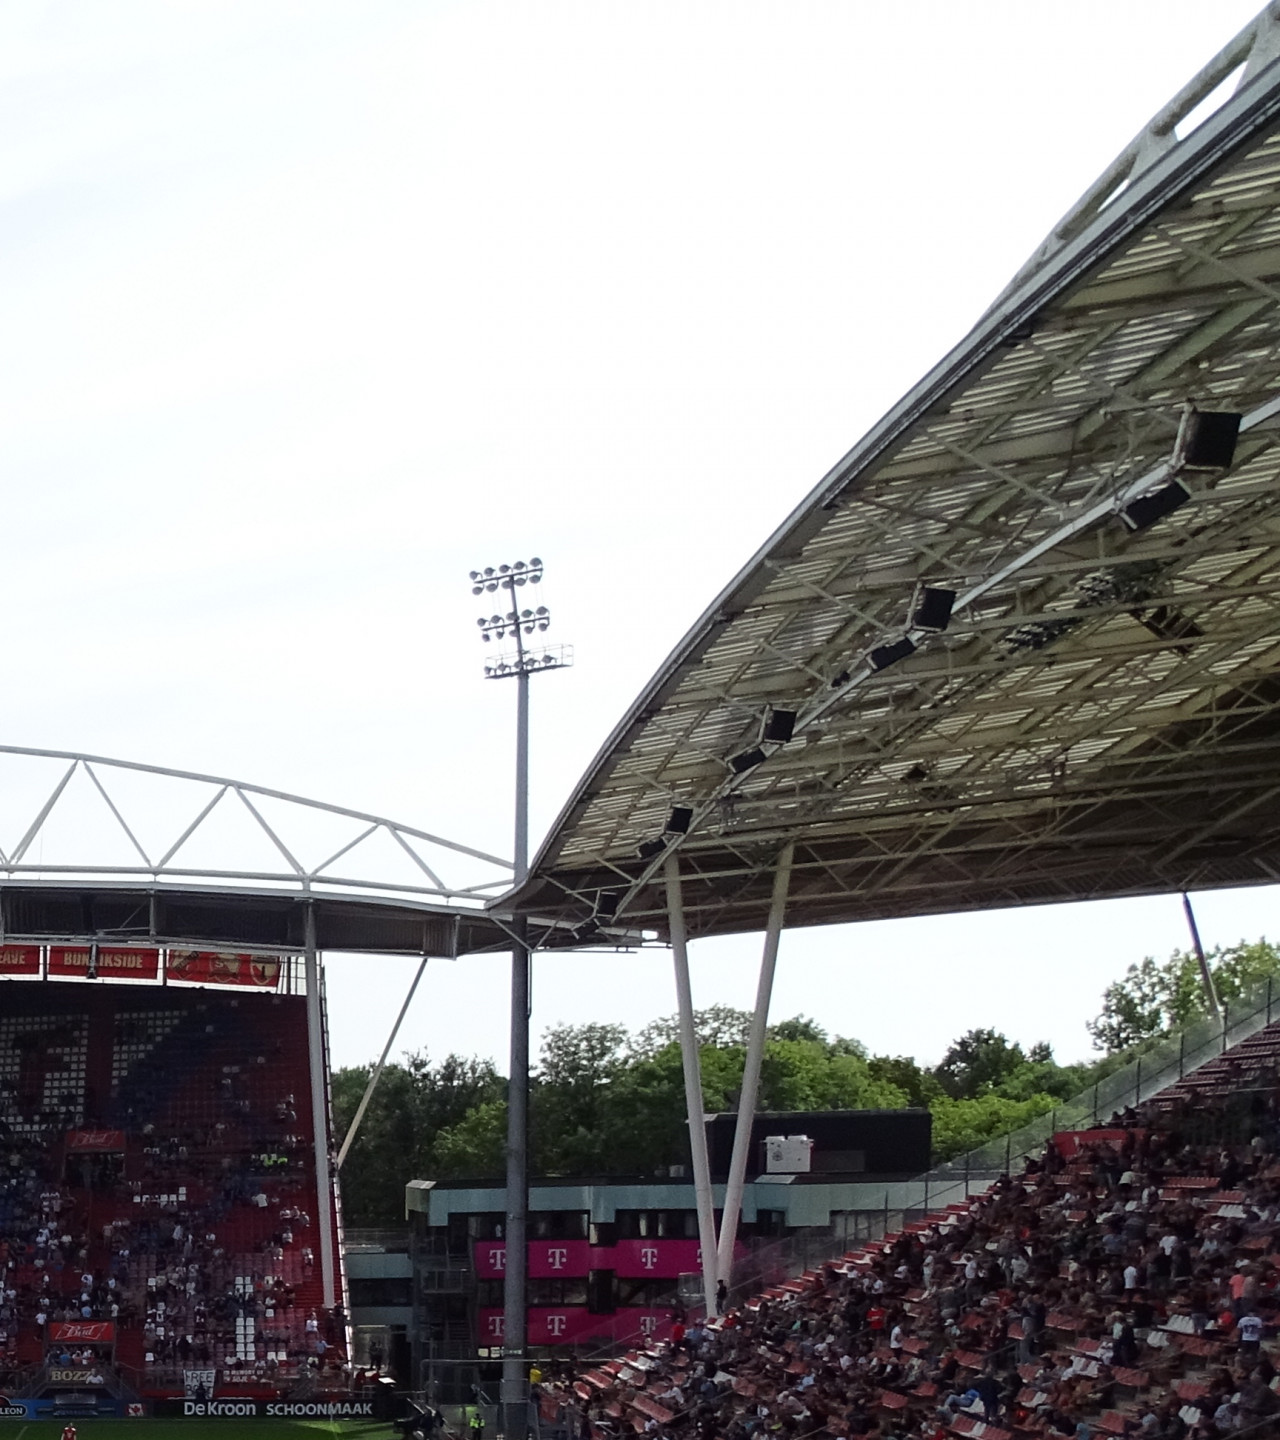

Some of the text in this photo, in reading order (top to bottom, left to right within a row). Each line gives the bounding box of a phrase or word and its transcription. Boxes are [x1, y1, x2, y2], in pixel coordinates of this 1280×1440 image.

[63, 952, 144, 969] BUNIKSIDE
[66, 1324, 96, 1338] Bud
[185, 1371, 214, 1383] FREE
[266, 1402, 373, 1416] SCHOONMAAK
